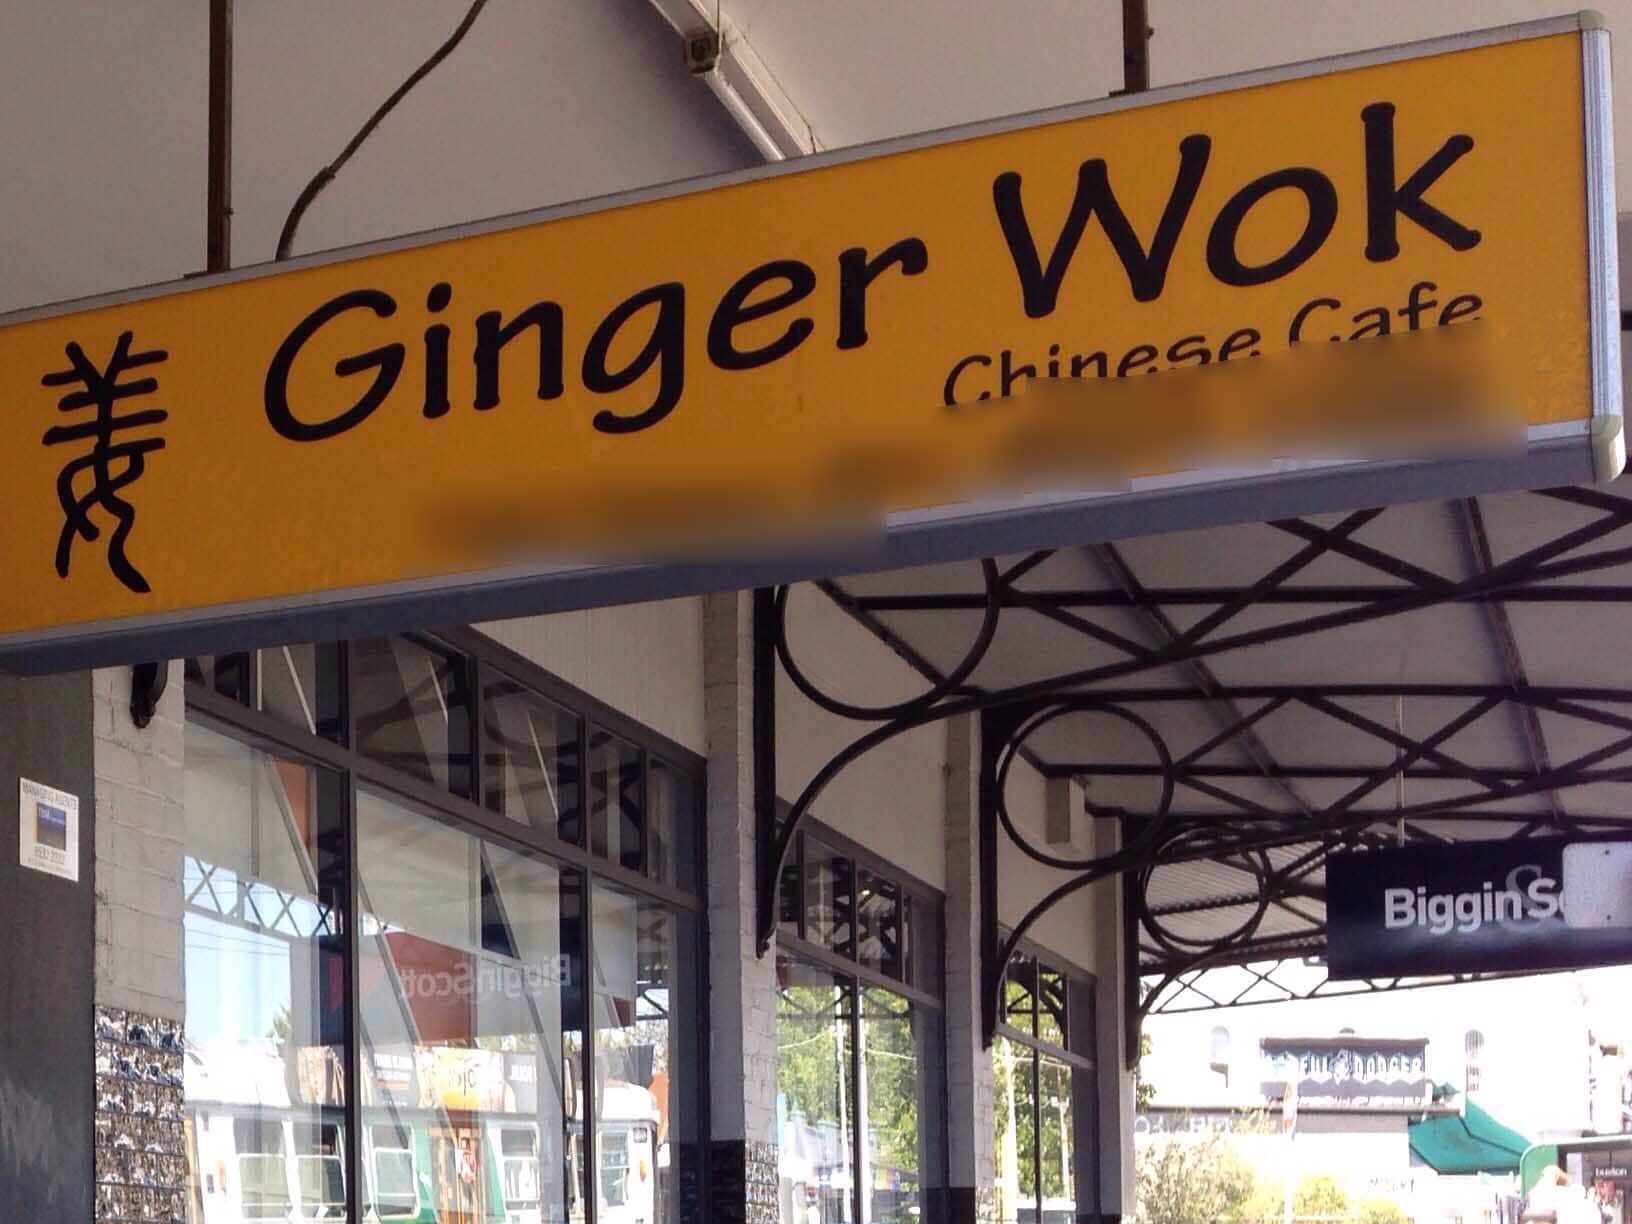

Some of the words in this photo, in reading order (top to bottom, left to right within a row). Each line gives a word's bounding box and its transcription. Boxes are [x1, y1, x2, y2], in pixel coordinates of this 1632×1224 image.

[264, 237, 928, 442] Ginger
[992, 102, 1482, 319] Wok
[1384, 881, 1522, 935] Biggin
